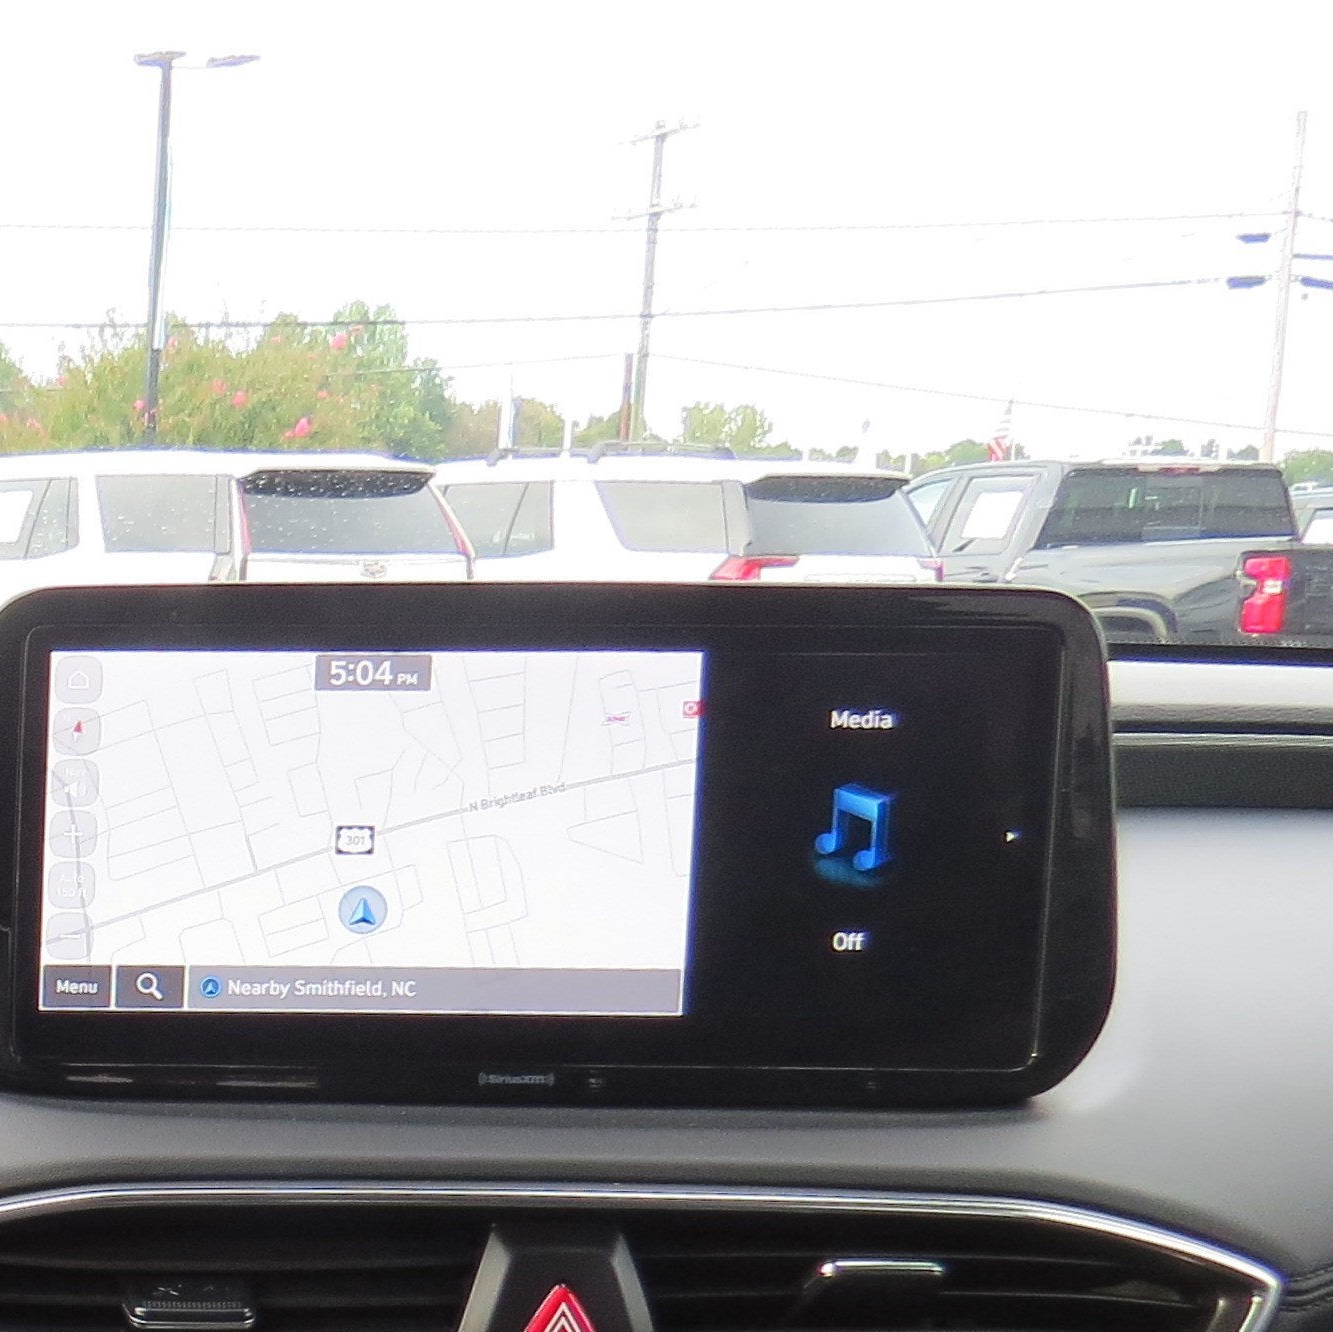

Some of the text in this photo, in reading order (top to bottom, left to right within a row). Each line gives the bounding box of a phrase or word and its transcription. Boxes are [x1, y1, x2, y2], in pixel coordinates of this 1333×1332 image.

[330, 660, 418, 686] 5:04 PM
[830, 709, 893, 730] Media
[481, 789, 537, 810] Brightleaf
[540, 782, 565, 797] Blvd
[346, 835, 365, 845] 301
[833, 932, 864, 951] Off
[55, 979, 98, 995] Menu
[228, 978, 416, 999] Nearby Smithfield, NC
